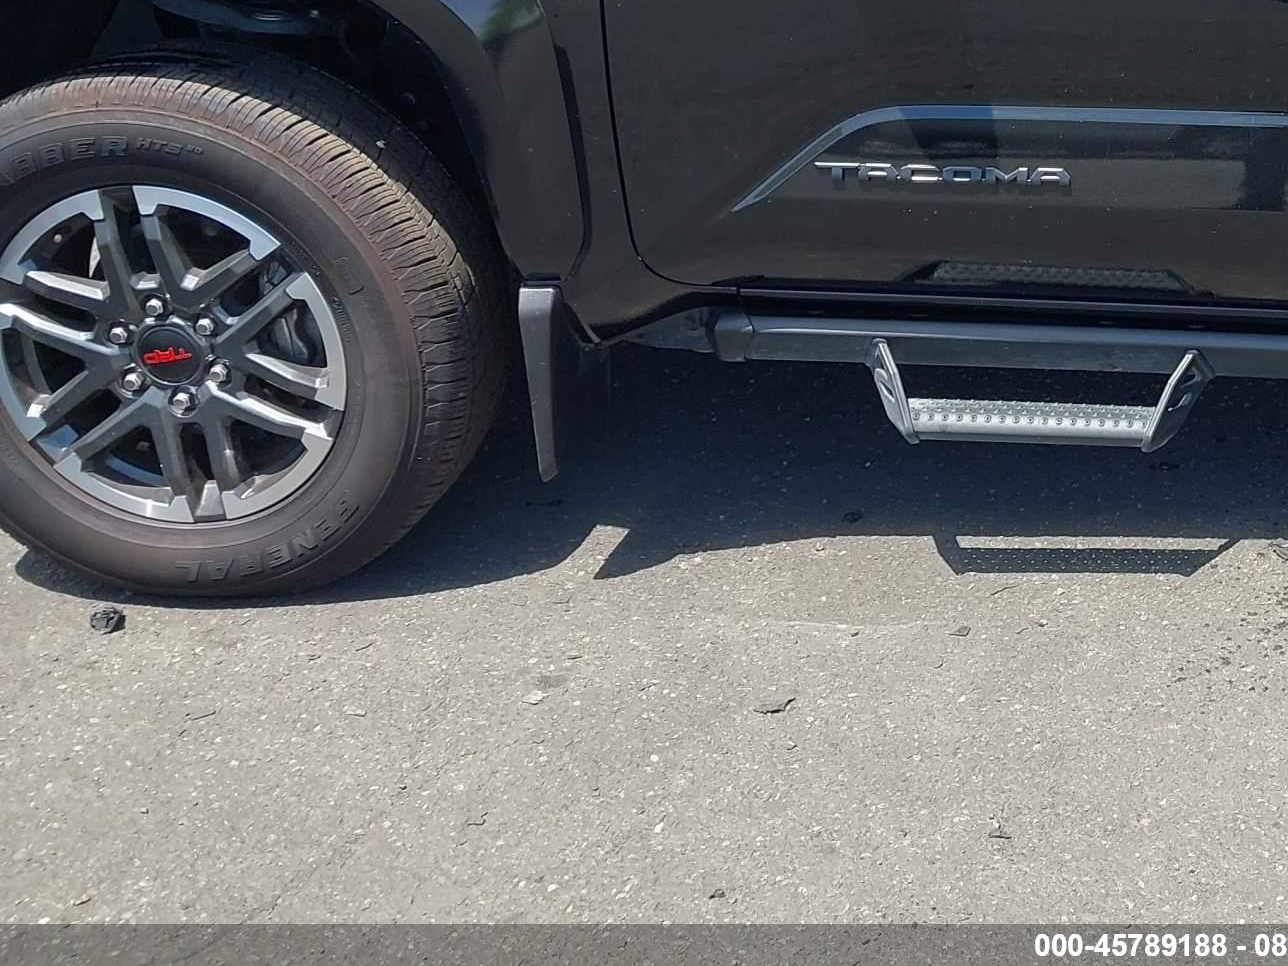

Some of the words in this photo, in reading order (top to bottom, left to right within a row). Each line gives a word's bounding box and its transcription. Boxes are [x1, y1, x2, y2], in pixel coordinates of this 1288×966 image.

[813, 160, 1073, 187] TACOMA
[142, 346, 193, 365] TRD
[173, 488, 361, 584] GENERAL
